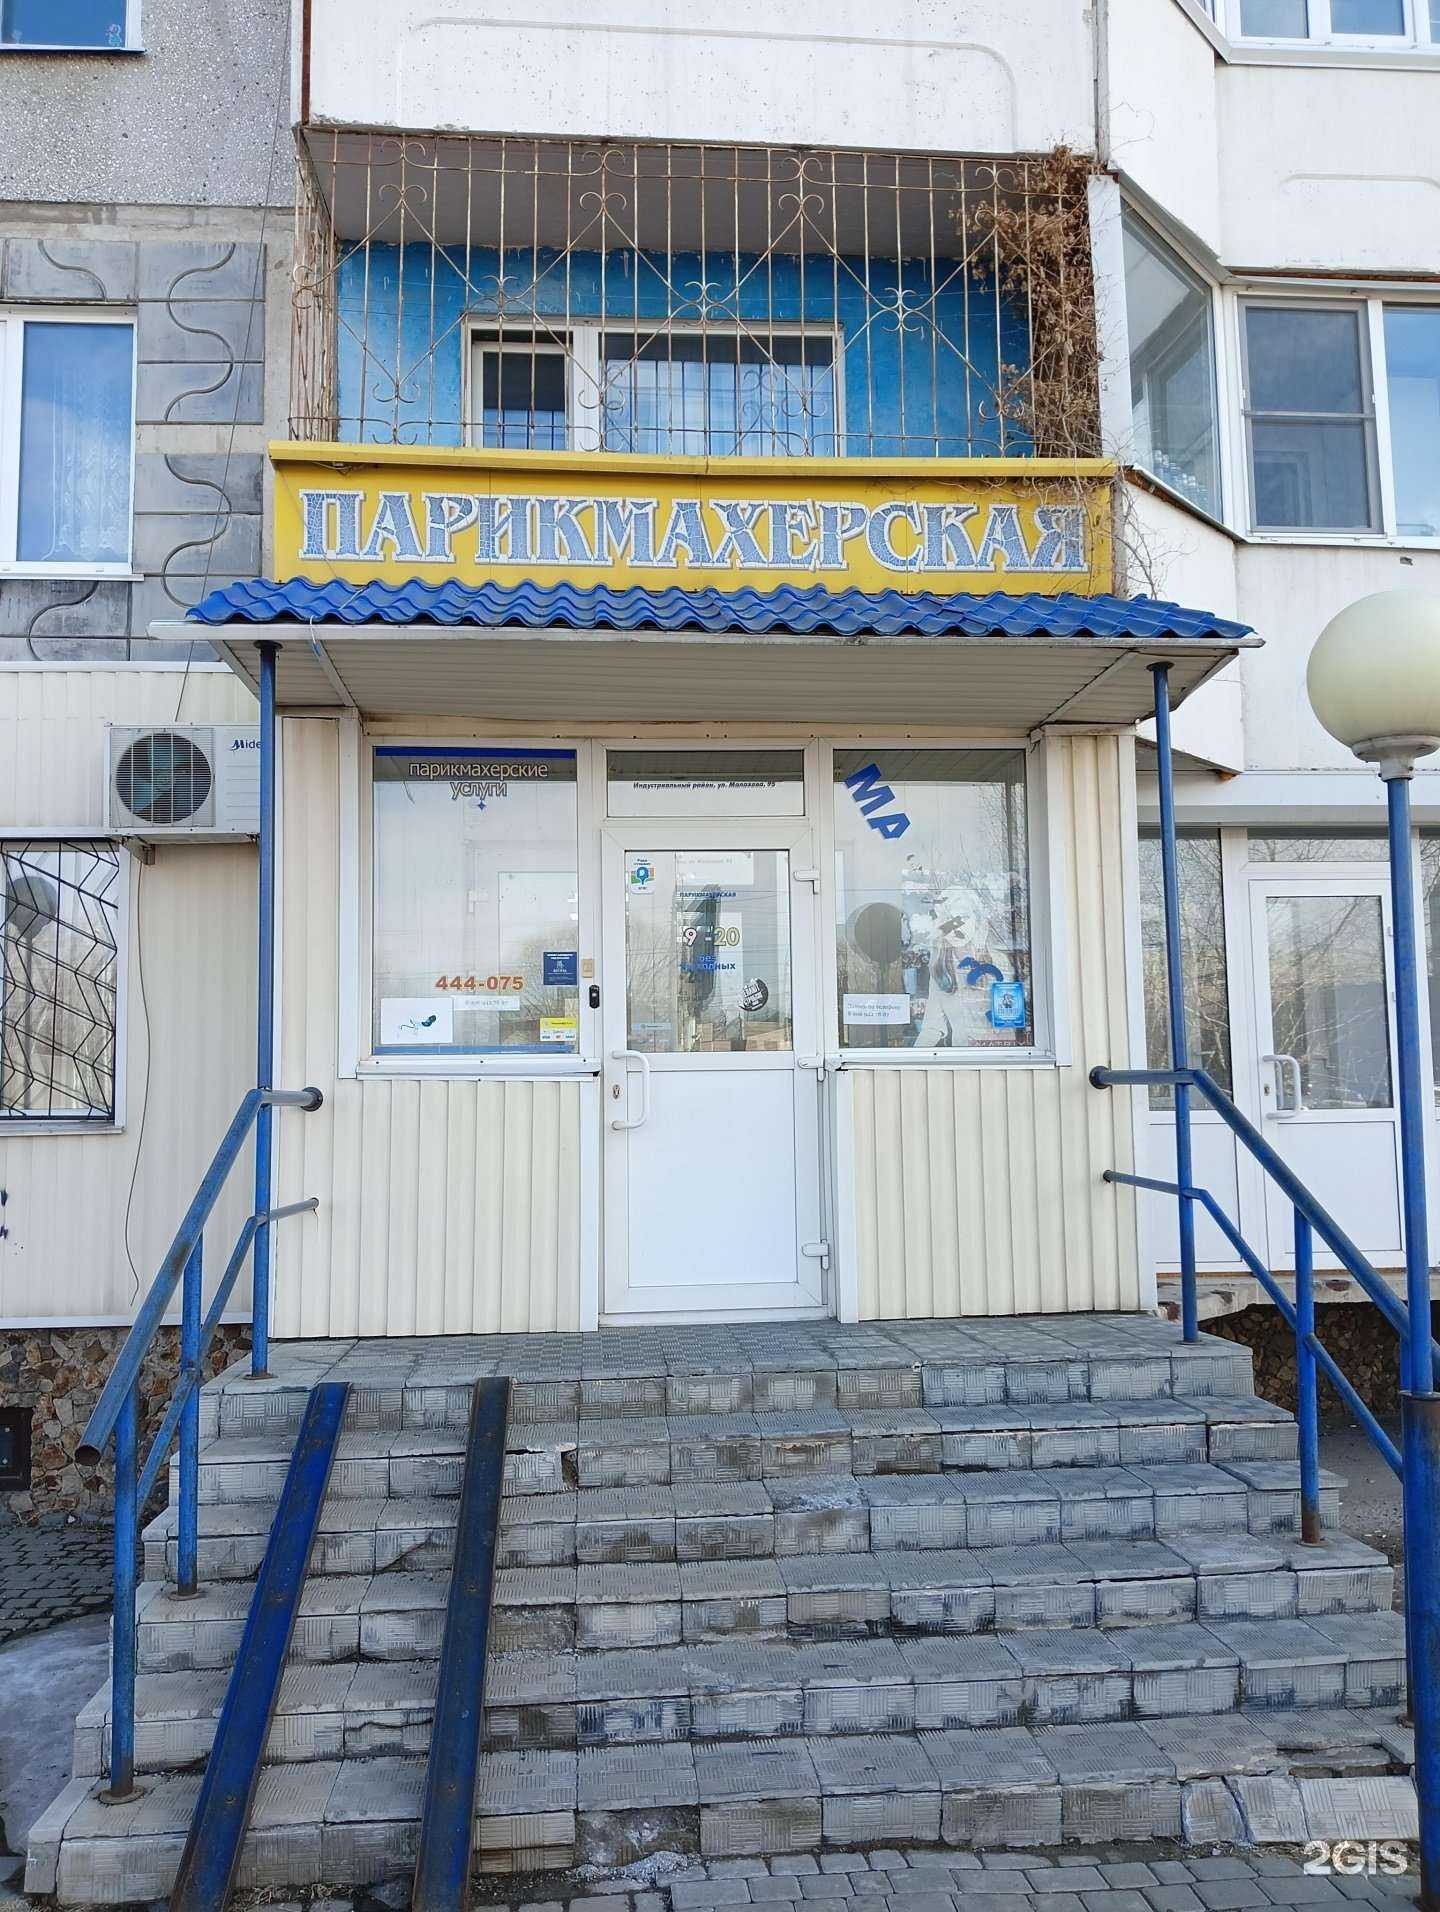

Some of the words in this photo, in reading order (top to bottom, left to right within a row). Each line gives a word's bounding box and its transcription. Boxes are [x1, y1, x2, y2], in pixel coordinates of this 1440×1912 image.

[299, 488, 1089, 572] ПАРИКМАХЕРСКАЯ
[230, 739, 261, 751] Mide
[409, 763, 549, 782] парикмахерские
[450, 781, 507, 800] услуги
[435, 975, 524, 991] 444-075
